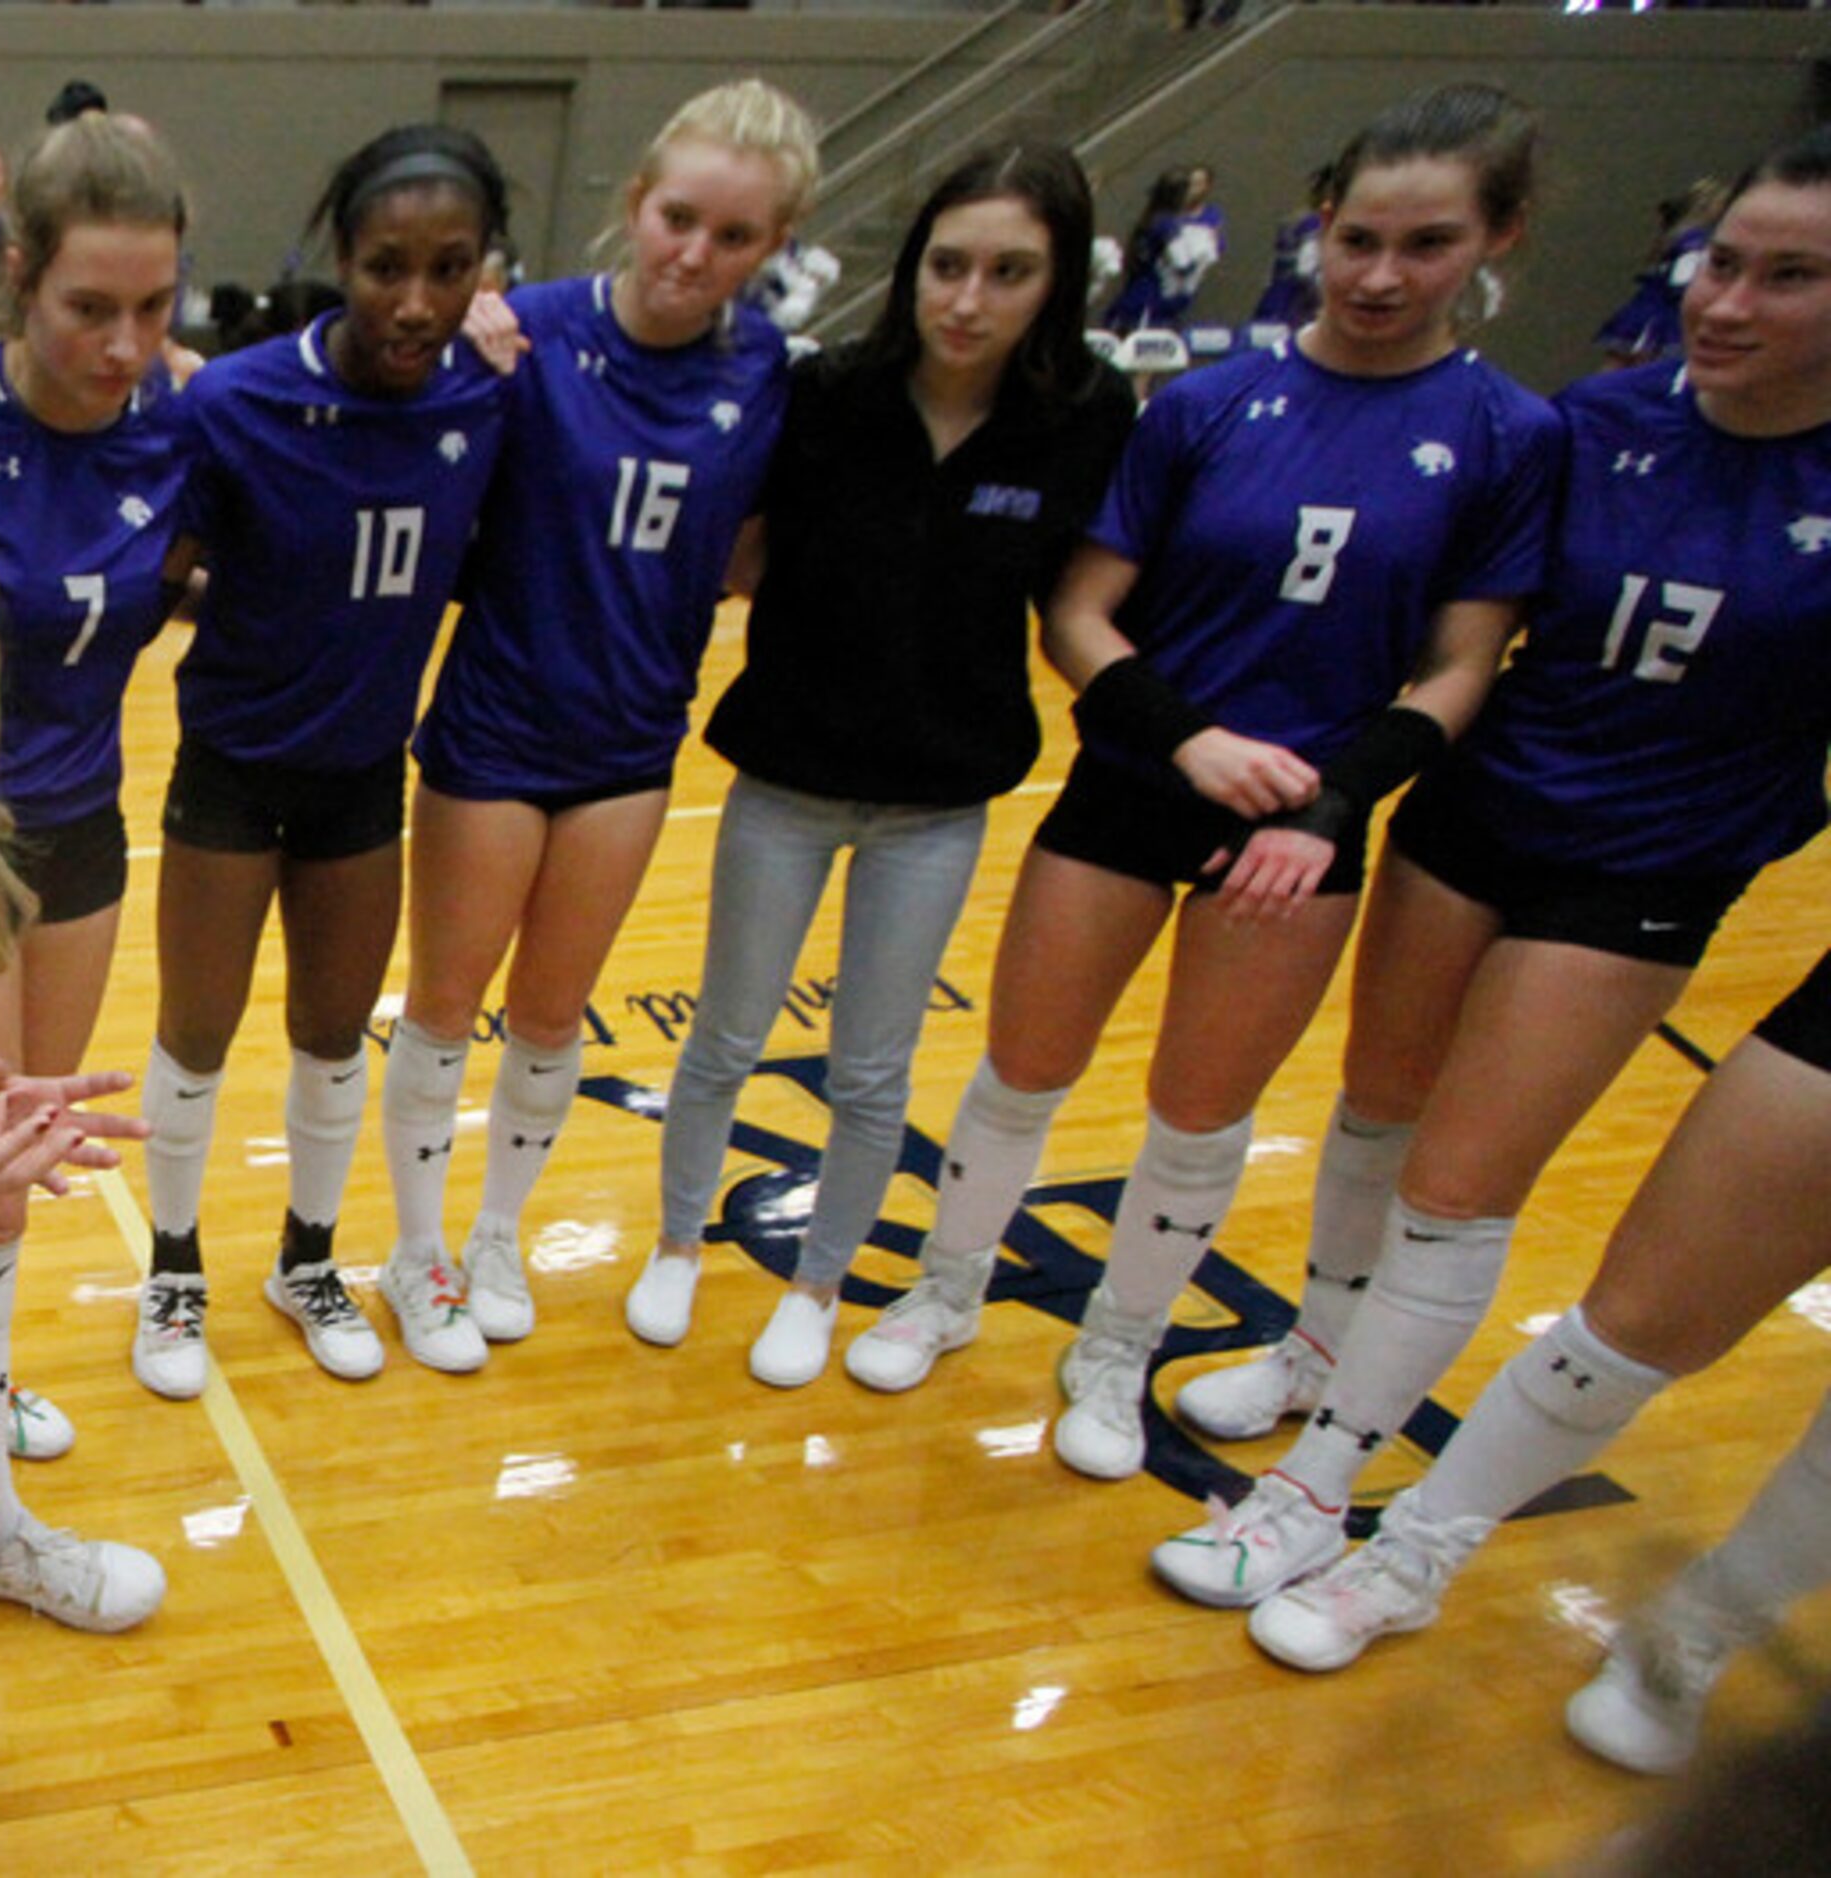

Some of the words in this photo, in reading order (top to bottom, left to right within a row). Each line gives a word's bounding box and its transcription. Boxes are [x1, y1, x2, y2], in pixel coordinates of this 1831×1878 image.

[610, 457, 690, 550] 16
[352, 508, 423, 598] 10
[1281, 506, 1355, 602] 8
[64, 574, 105, 664] 7
[1603, 575, 1722, 678] 12
